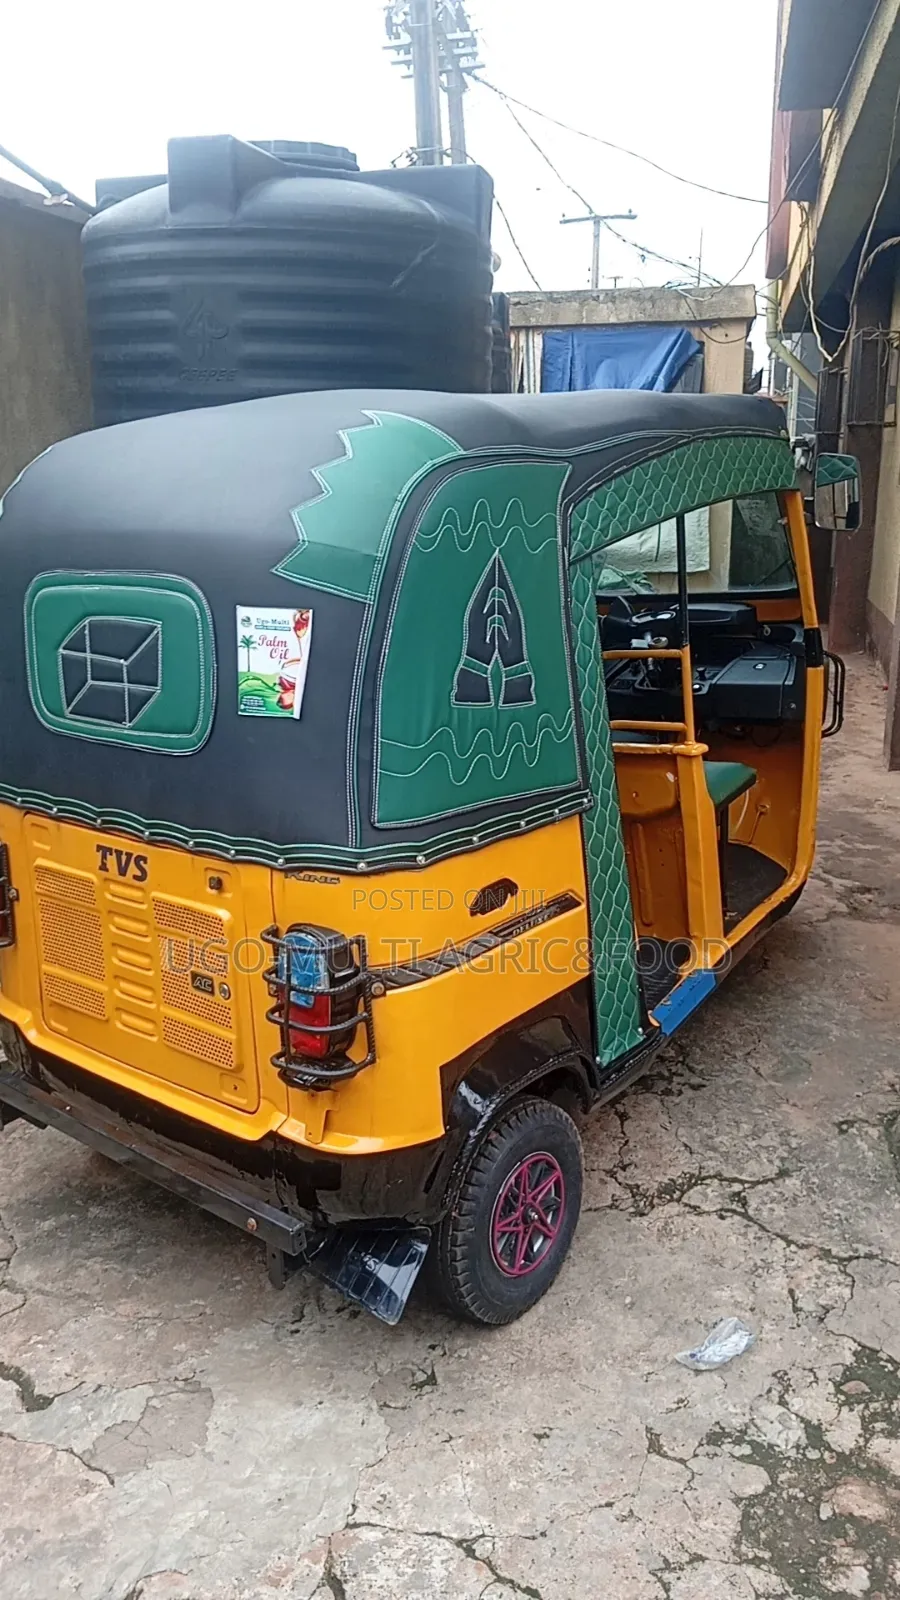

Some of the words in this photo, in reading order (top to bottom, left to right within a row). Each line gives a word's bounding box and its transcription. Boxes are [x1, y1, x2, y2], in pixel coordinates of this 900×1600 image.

[258, 634, 288, 648] Palm
[269, 647, 290, 660] Oil
[95, 843, 149, 882] TVS
[284, 870, 341, 885] KING
